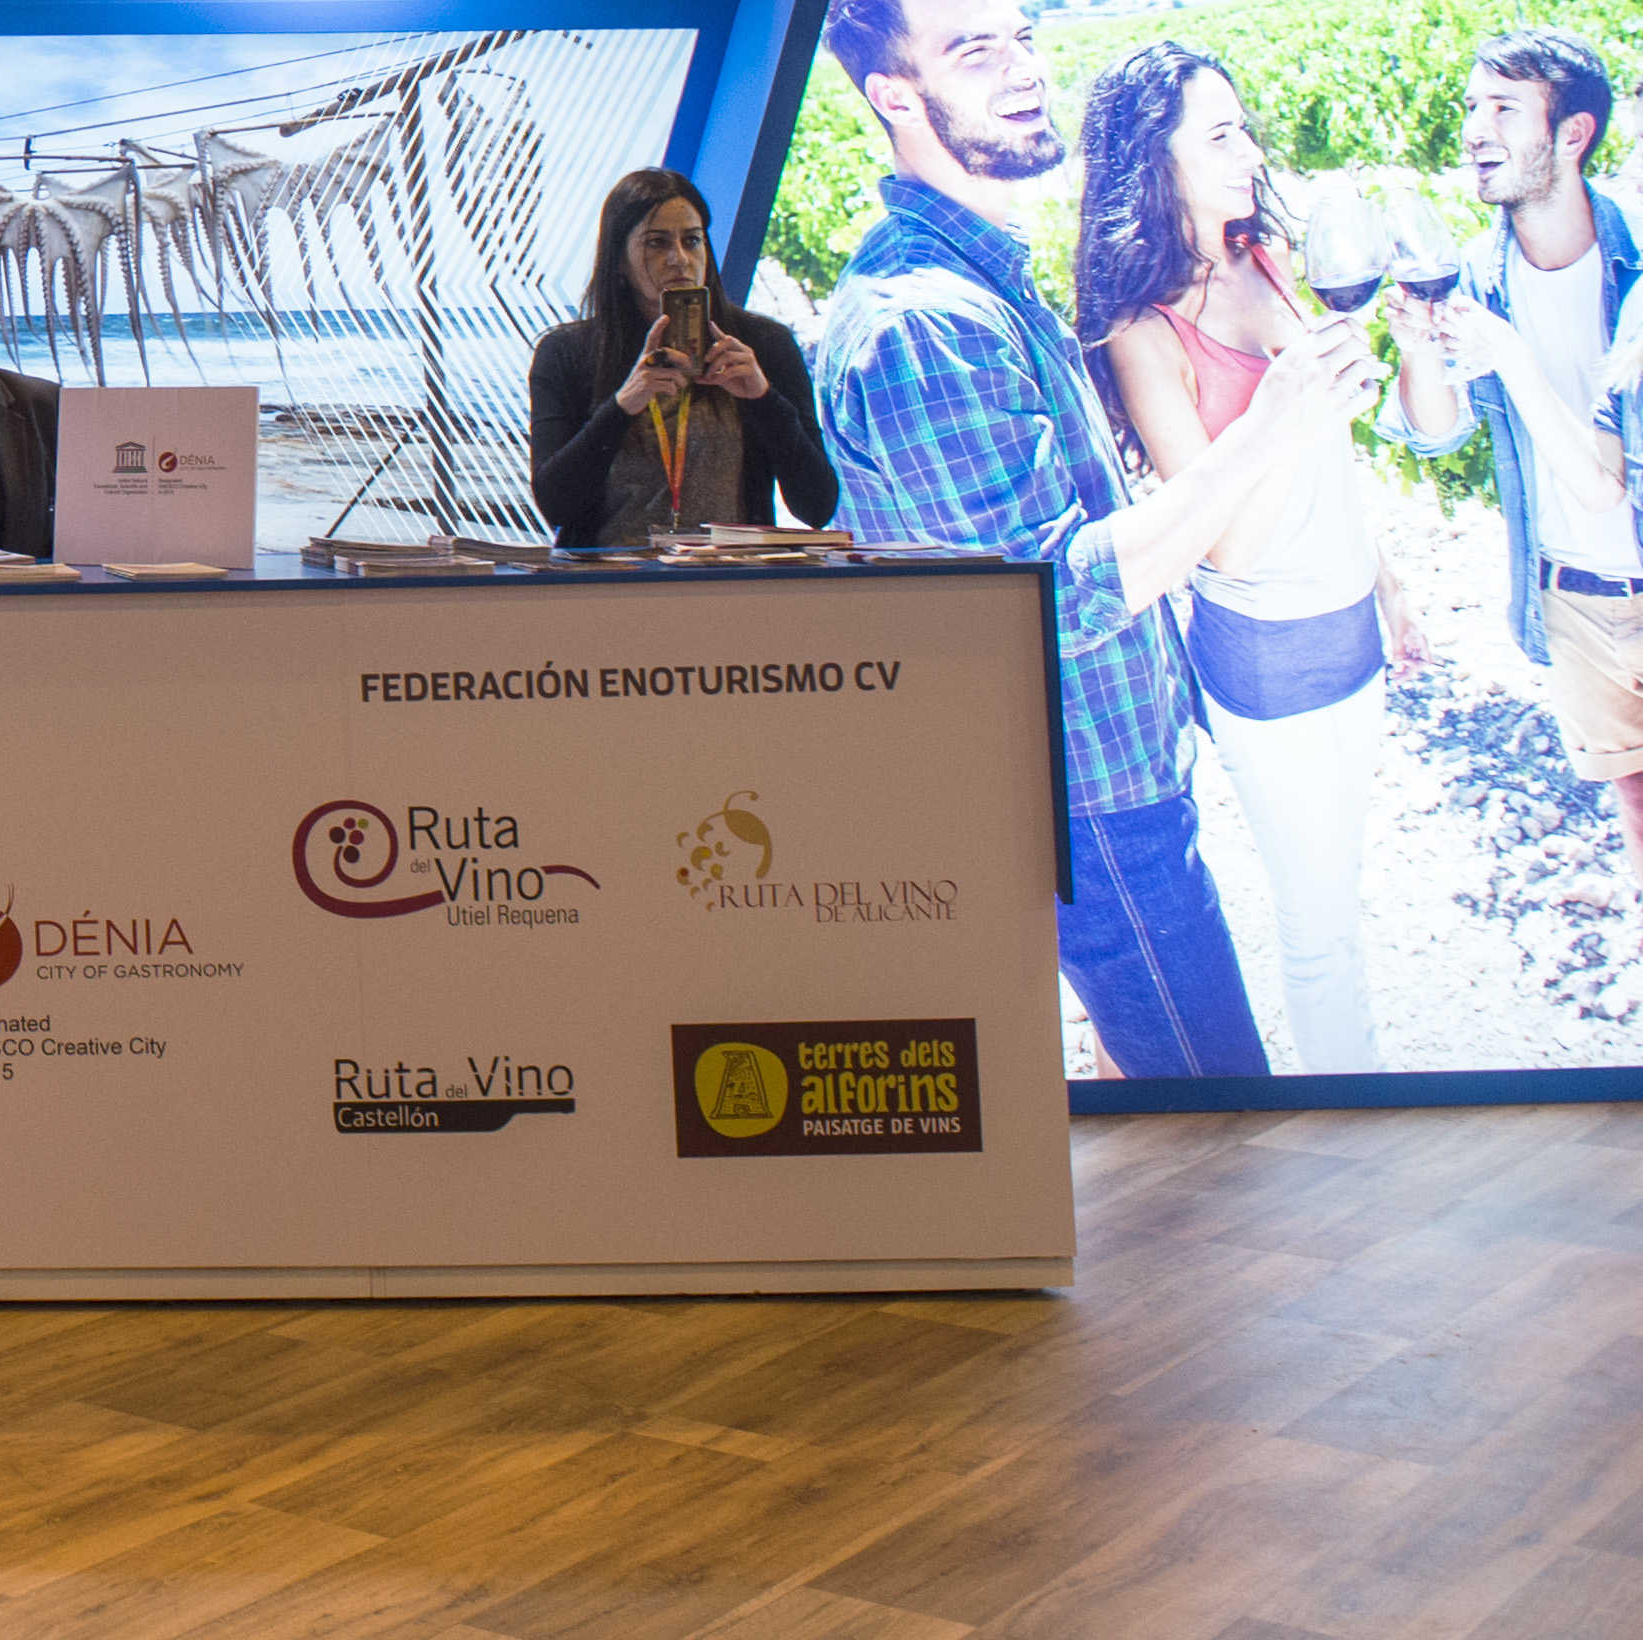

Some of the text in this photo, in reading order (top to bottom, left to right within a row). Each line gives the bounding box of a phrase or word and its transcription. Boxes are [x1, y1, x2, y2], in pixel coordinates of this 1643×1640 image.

[360, 661, 902, 702] FEDERACIÓN ENOTURISMO CV
[408, 806, 519, 850] Ruta
[410, 857, 544, 901] del Vino
[718, 879, 958, 908] RUTA DEL VINO
[447, 904, 580, 928] Utiel Requena
[816, 904, 957, 923] DE ALICANTE
[35, 910, 194, 956] DÉNIA
[36, 962, 245, 980] CITY OF GASTRONOMY
[41, 1038, 122, 1056] Creative
[129, 1037, 167, 1058] City
[798, 1040, 956, 1070] terres dels
[335, 1055, 575, 1099] Ruta del Vino
[801, 1072, 959, 1115] alforins
[337, 1106, 440, 1129] Castellón
[803, 1116, 962, 1137] PAISATGE DE VINS
